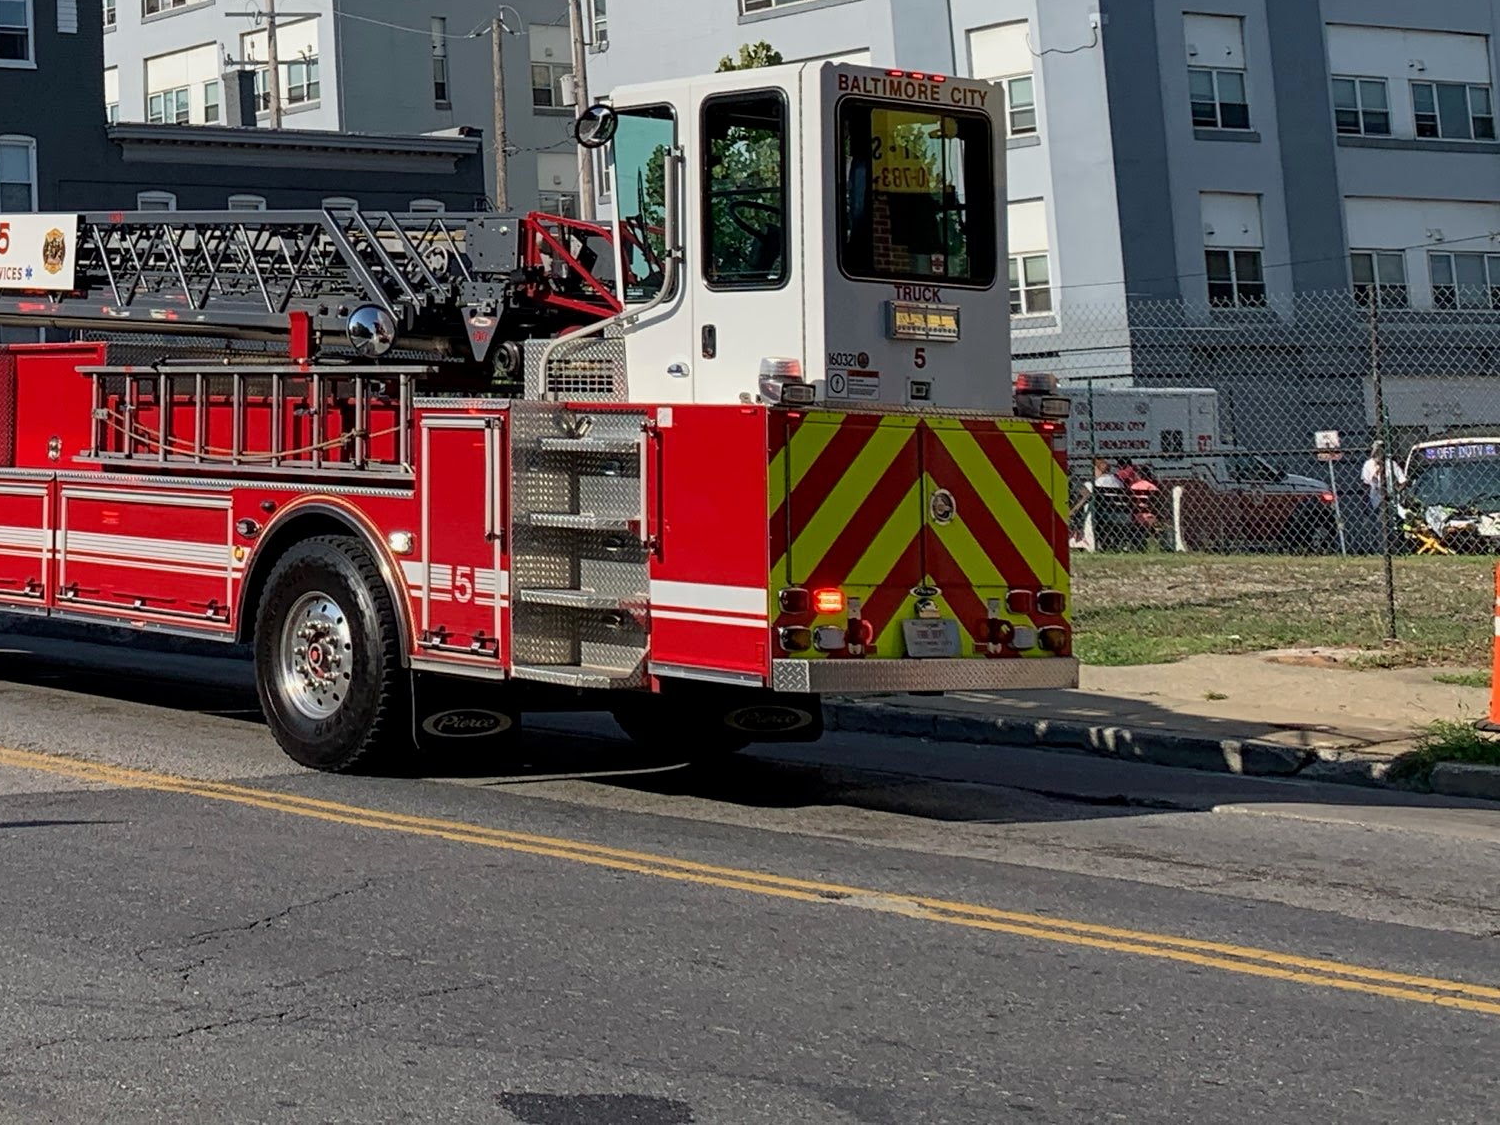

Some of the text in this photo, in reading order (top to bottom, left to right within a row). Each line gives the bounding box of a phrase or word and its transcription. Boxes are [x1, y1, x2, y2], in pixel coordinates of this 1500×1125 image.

[838, 74, 988, 107] BALTIMORE CITY
[894, 284, 942, 303] TRUCK
[828, 352, 857, 367] 160321
[913, 347, 927, 369] 5
[1437, 446, 1483, 459] OFF DUTY
[454, 566, 472, 603] 5
[437, 714, 497, 732] Pierce
